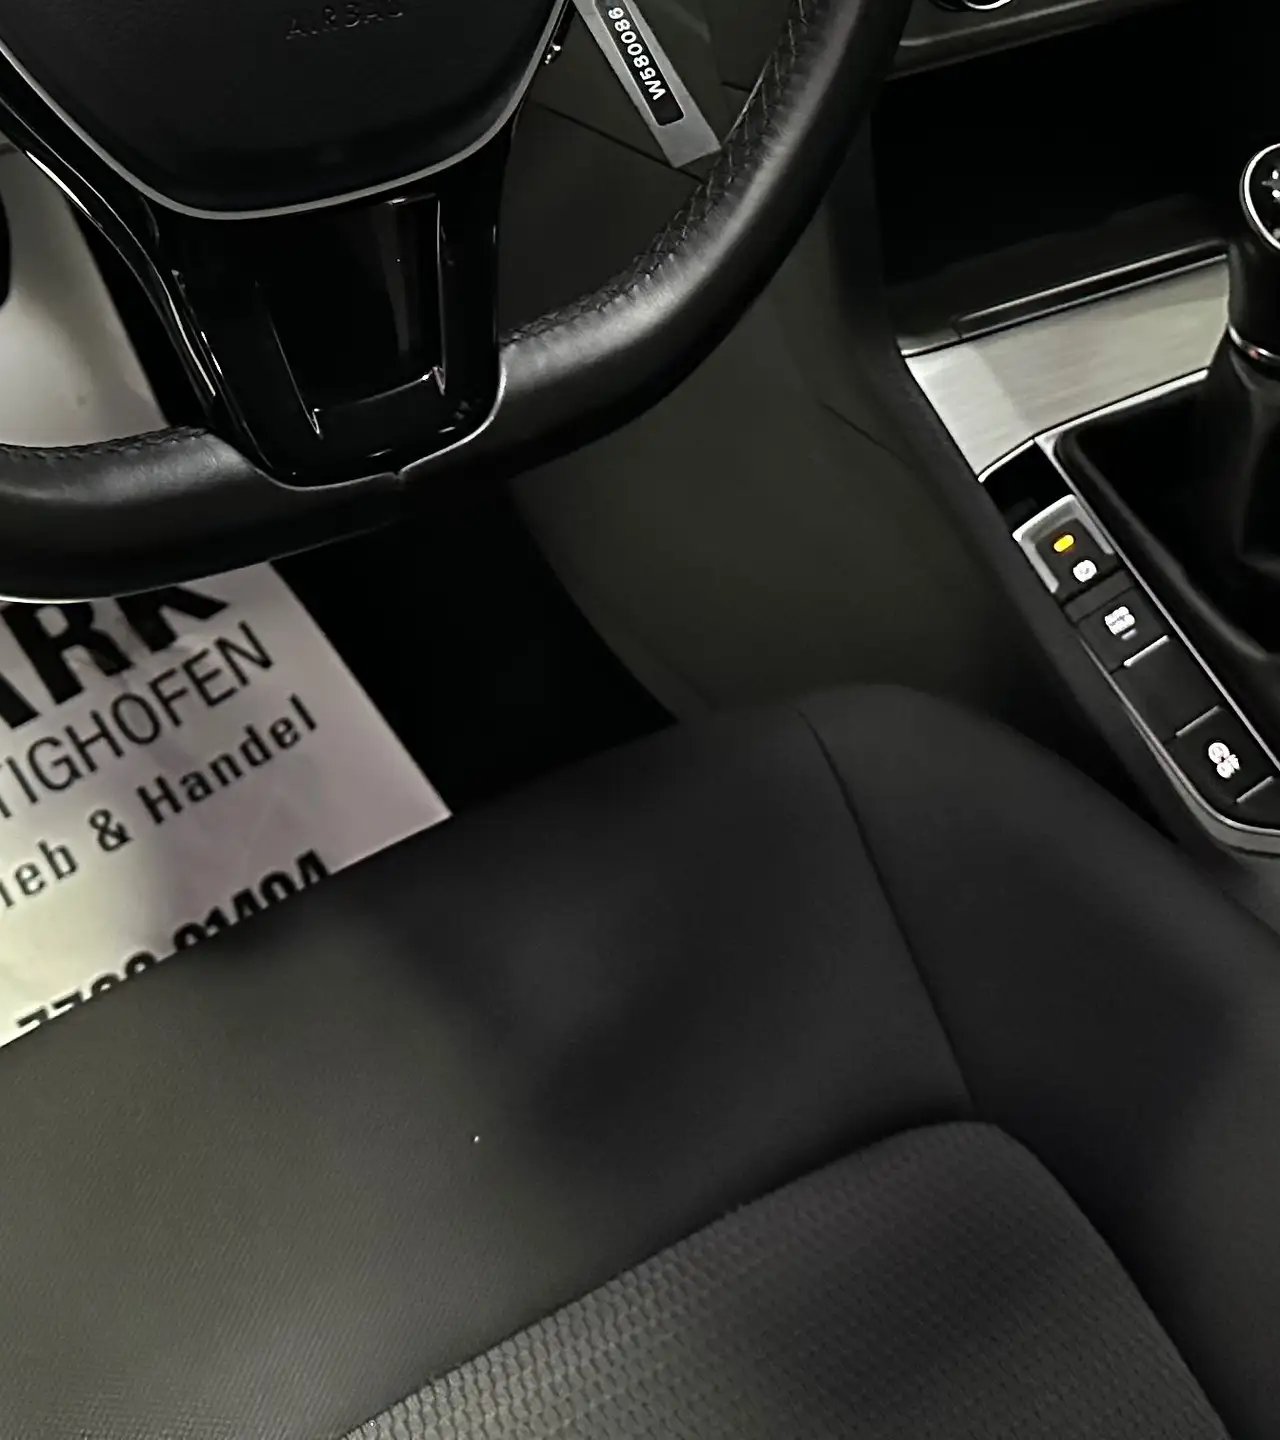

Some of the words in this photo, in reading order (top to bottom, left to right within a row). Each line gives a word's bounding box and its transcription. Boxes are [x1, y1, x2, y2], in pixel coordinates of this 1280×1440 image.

[606, 5, 667, 101] W580086
[88, 808, 132, 853] &
[136, 694, 318, 825] Handel
